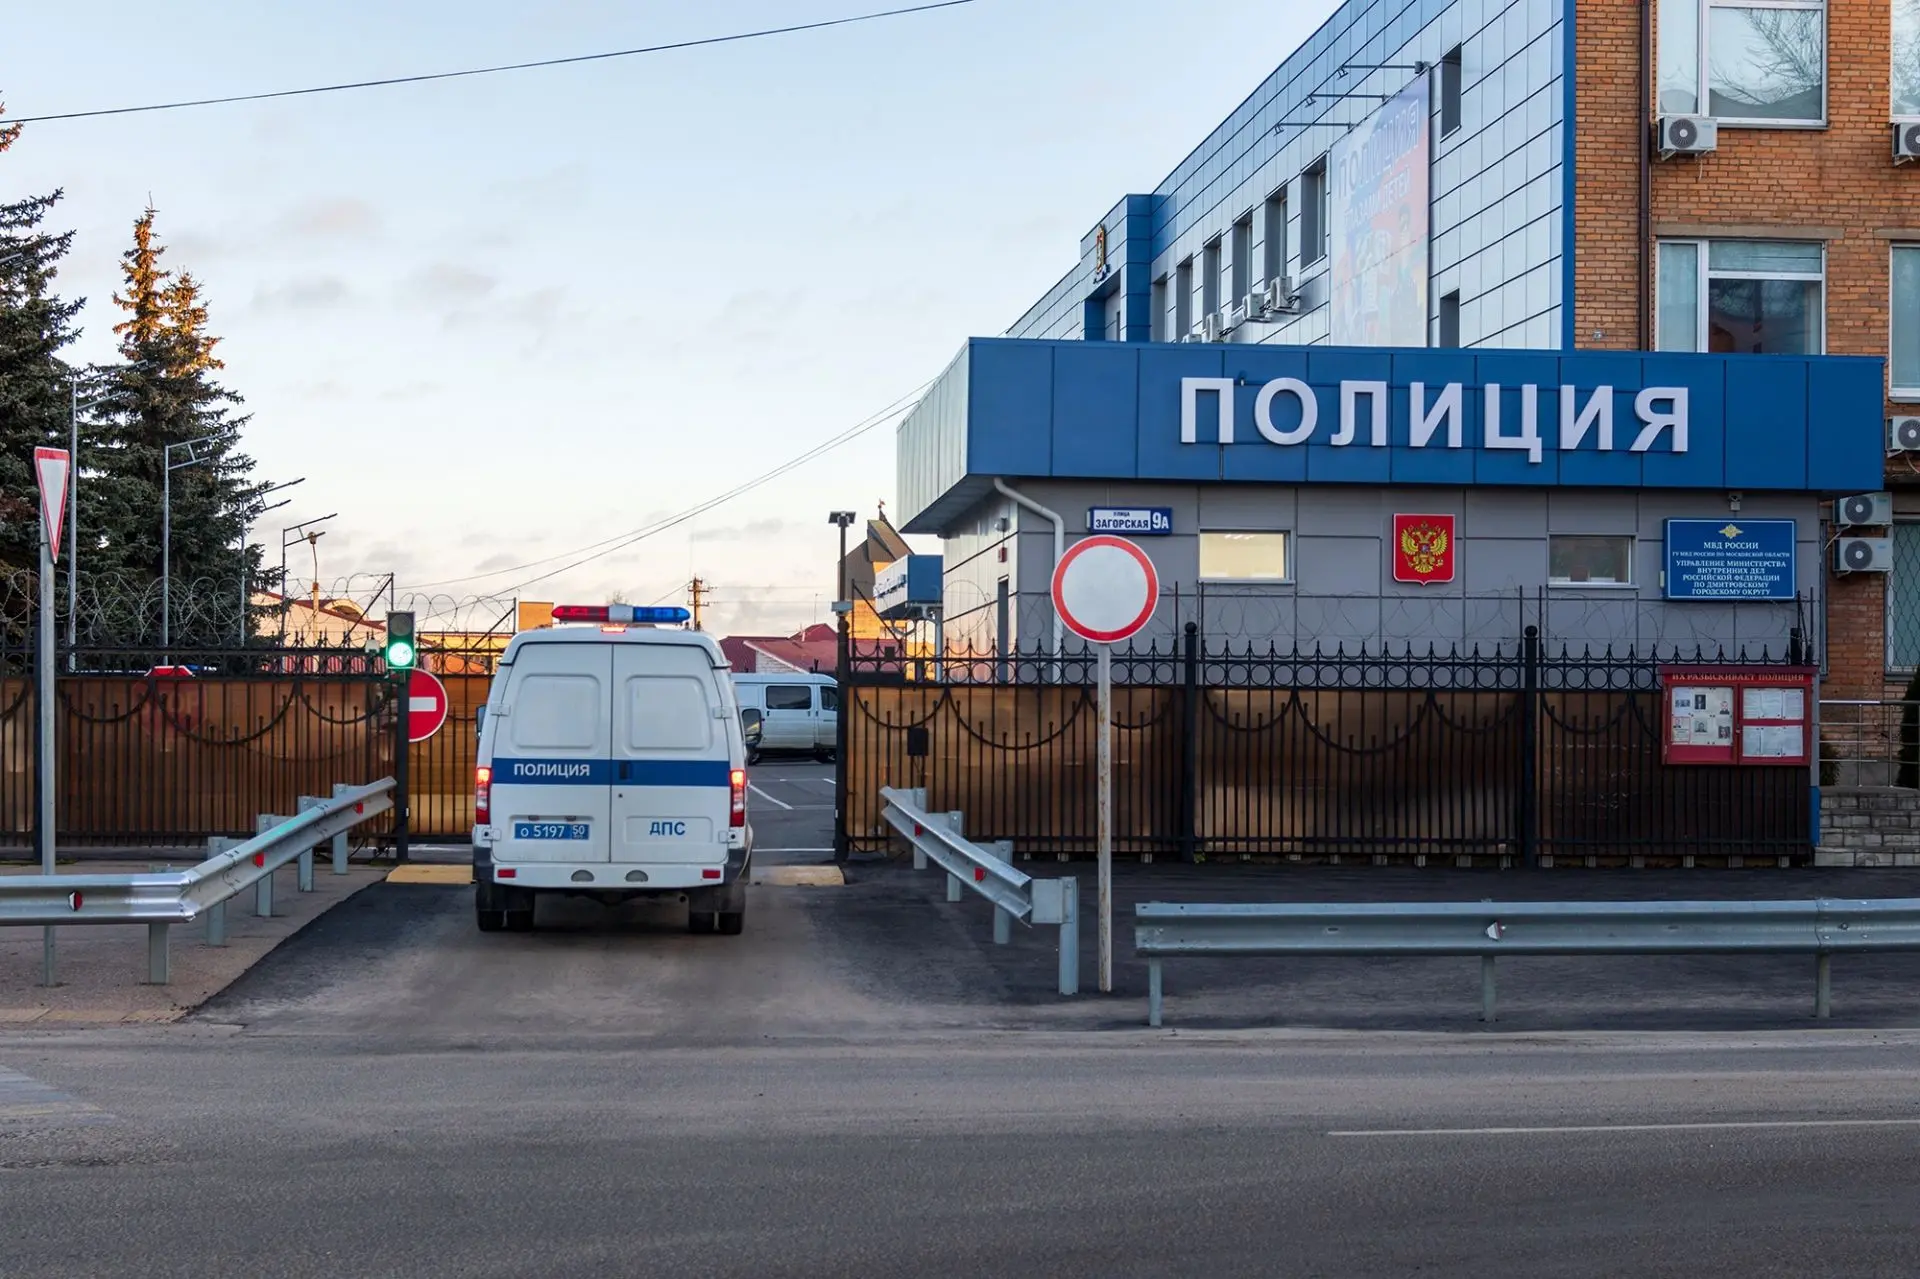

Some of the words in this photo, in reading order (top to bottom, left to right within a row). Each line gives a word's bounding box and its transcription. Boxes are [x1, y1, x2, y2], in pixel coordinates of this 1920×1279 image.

[1338, 98, 1419, 203] ПОЛИЦИЯ
[1180, 376, 1689, 464] ПОЛИЦИЯ
[1095, 519, 1149, 529] ЗАГОРСКАЯ
[1152, 512, 1169, 529] 9А
[1682, 573, 1732, 581] РОССИЙСКОЙ
[1759, 674, 1804, 682] ПОЛИЦИЯ
[514, 763, 590, 779] ПОЛИЦИЯ
[533, 825, 565, 838] 5197
[572, 824, 585, 835] 50
[649, 821, 685, 836] ДПС
